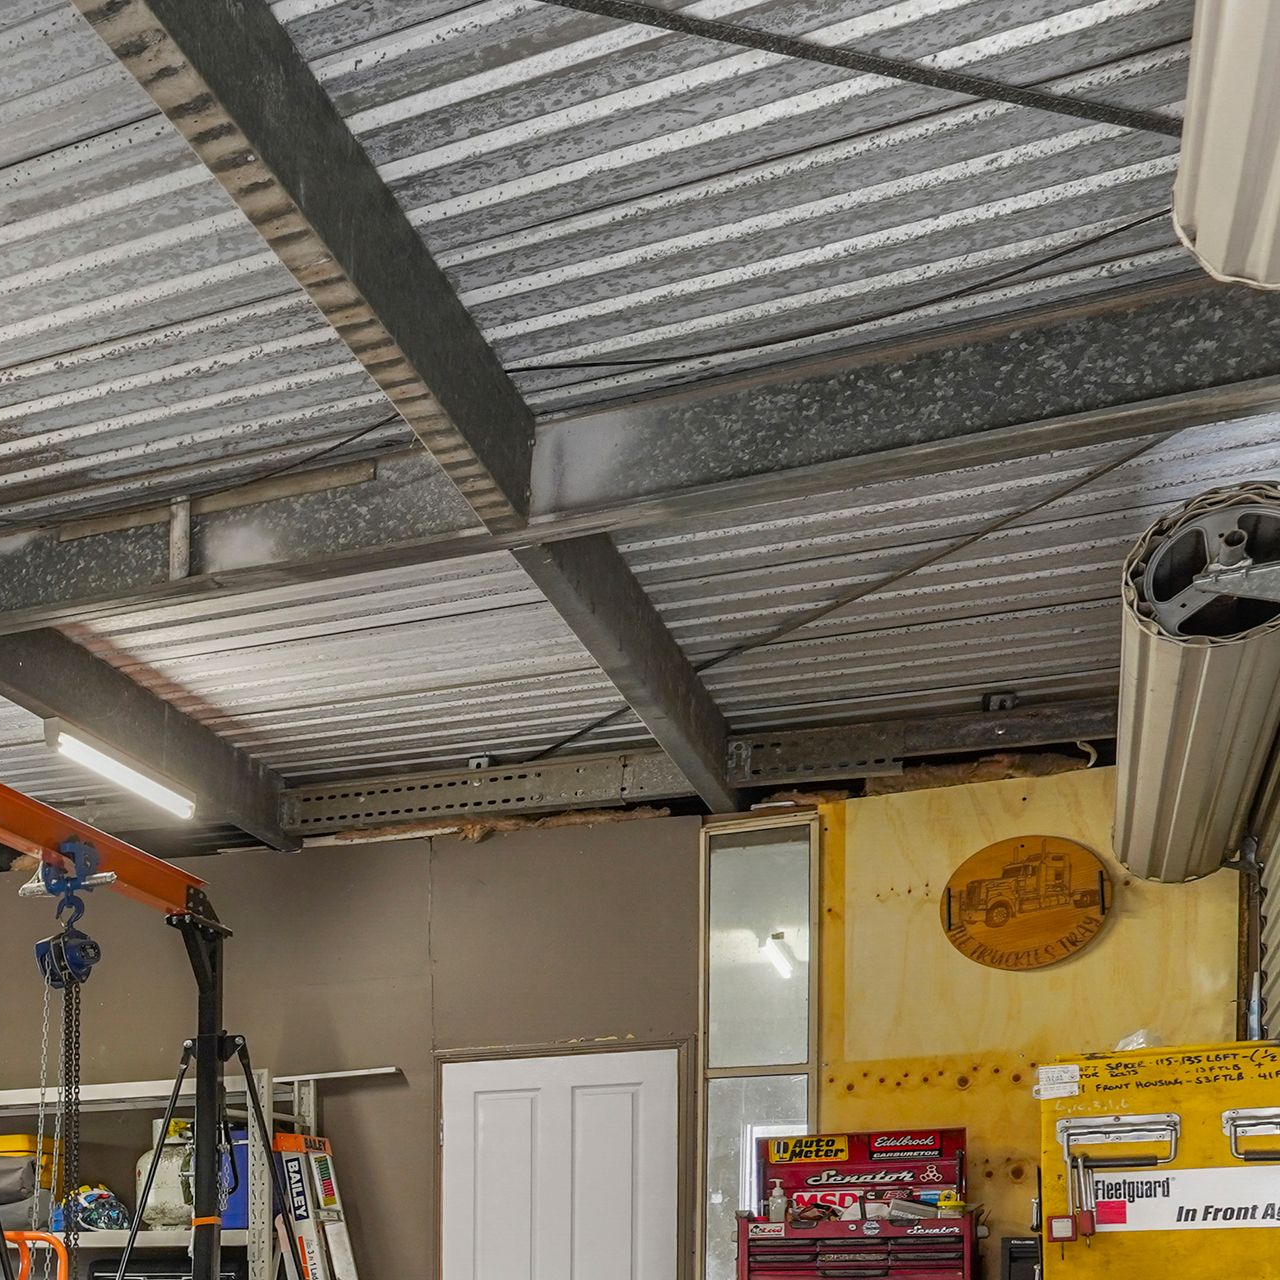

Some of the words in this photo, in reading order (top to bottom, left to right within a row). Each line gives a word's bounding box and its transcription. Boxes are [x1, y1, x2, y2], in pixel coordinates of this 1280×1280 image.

[1096, 1082, 1130, 1092] FRONT
[1135, 1077, 1183, 1088] HOUSING
[305, 1138, 326, 1151] BAILEY
[793, 1138, 835, 1149] Auto
[874, 1135, 935, 1147] Edelbrock
[790, 1148, 845, 1161] Meter
[873, 1150, 940, 1159] CARBURETOR
[806, 1169, 914, 1185] Senator
[287, 1161, 308, 1220] BAILEY
[1095, 1177, 1170, 1204] Fleetguard
[795, 1193, 859, 1208] MSD
[1176, 1206, 1197, 1222] In
[1202, 1204, 1257, 1221] Front
[906, 1225, 961, 1235] Senator
